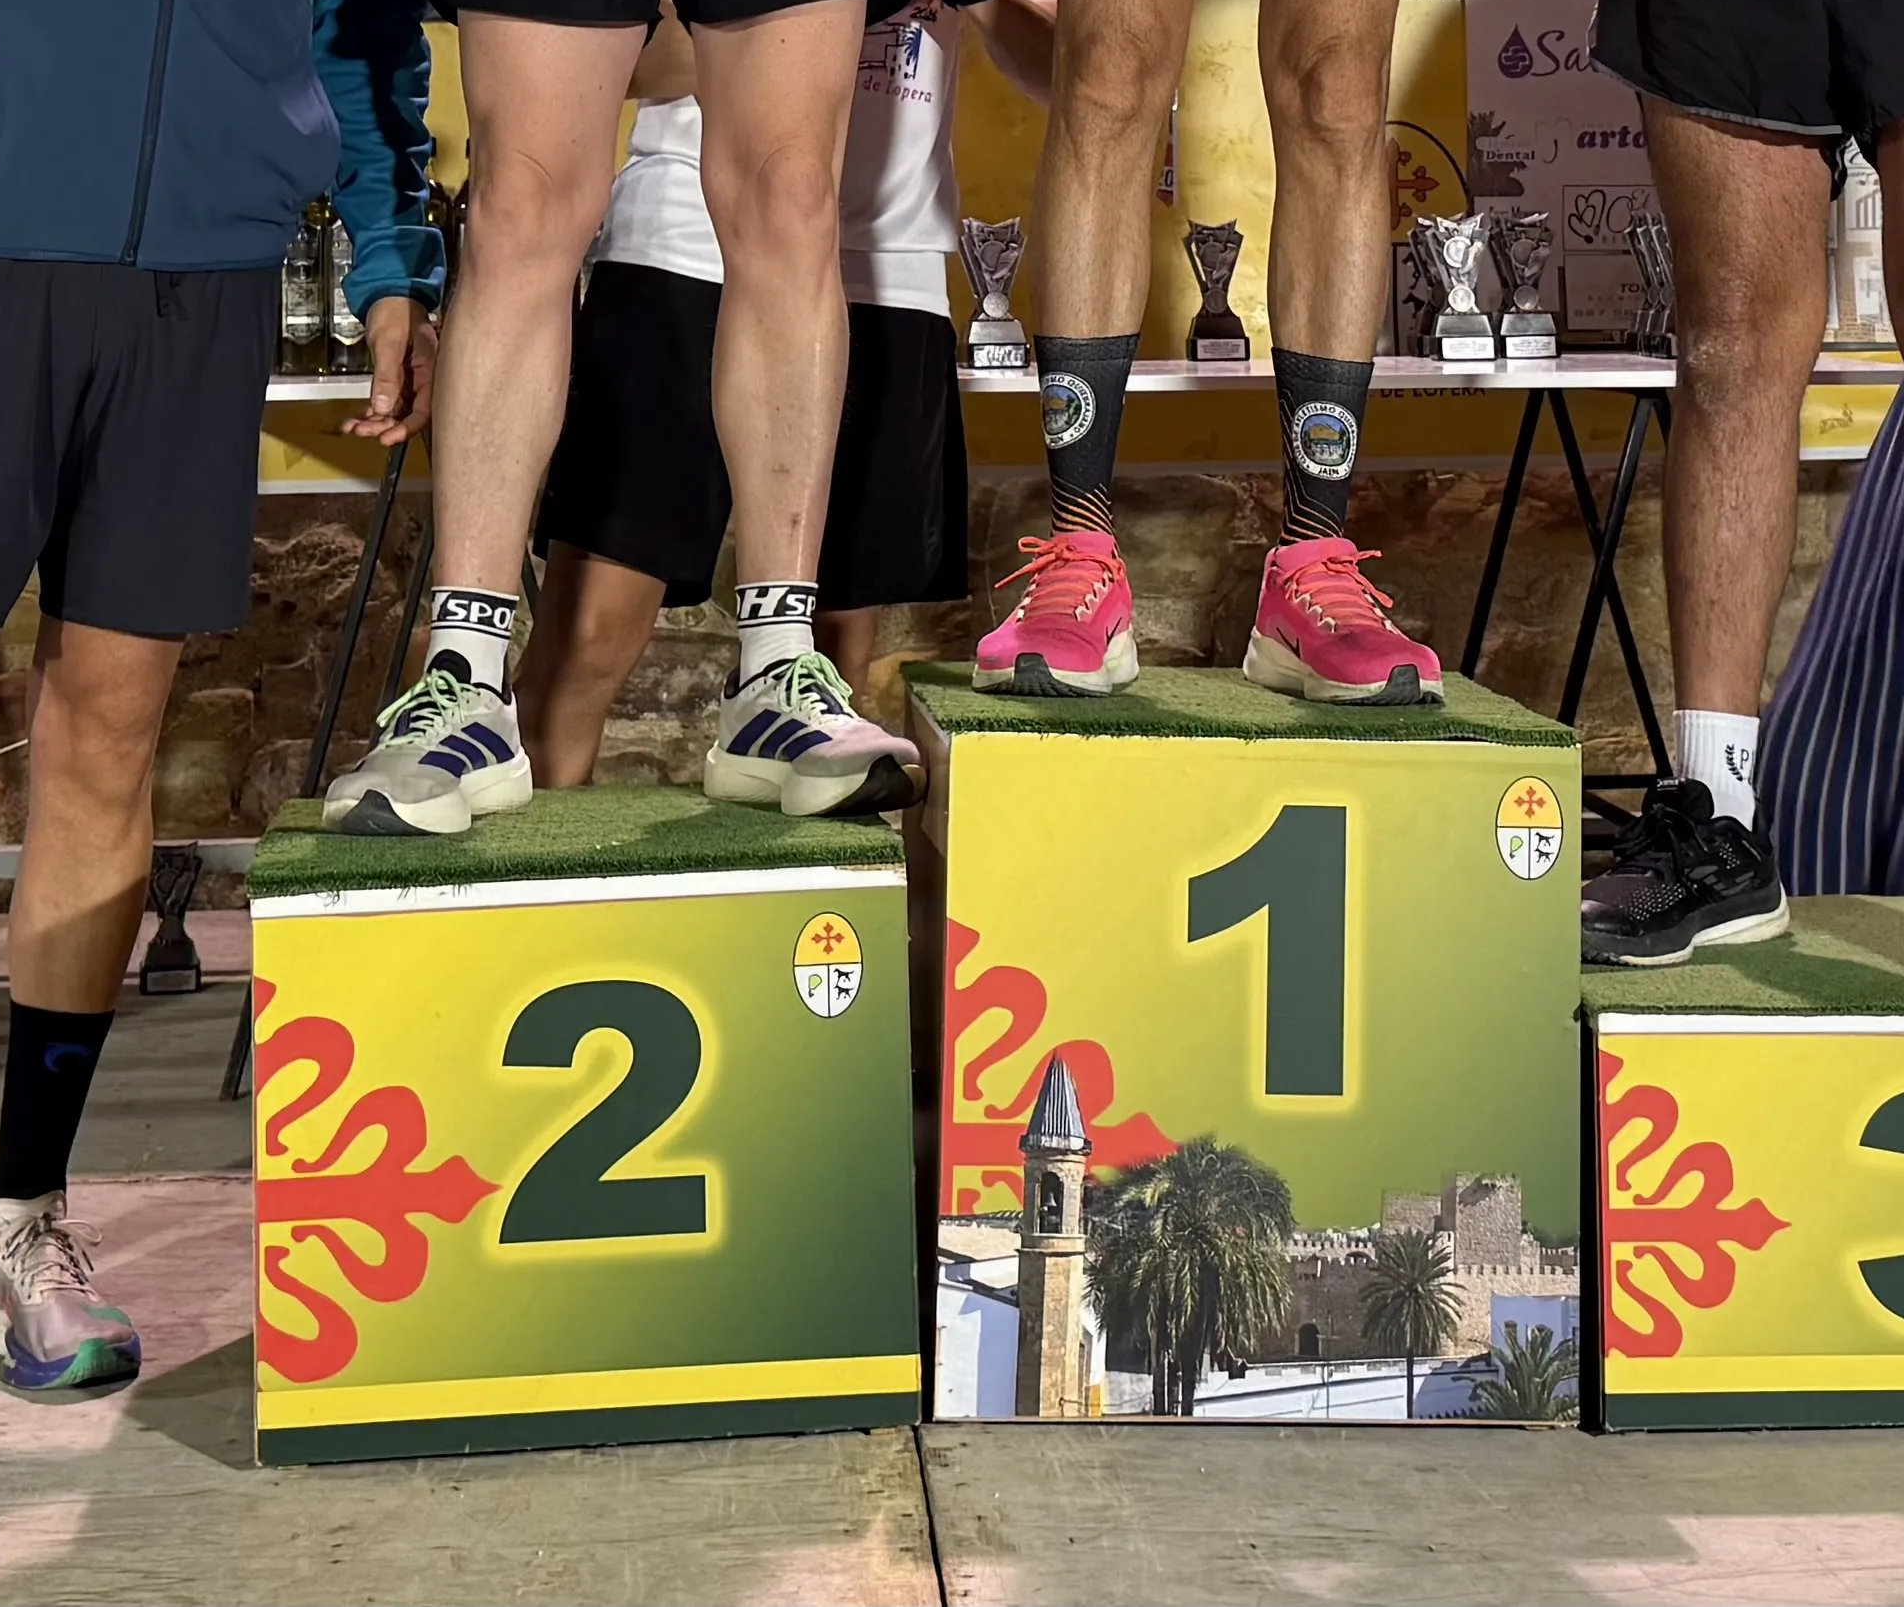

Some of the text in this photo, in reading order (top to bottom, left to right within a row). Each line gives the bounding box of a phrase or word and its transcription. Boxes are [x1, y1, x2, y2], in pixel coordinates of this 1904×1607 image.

[1530, 30, 1600, 76] Sa
[445, 598, 516, 630] SPO
[1188, 805, 1347, 1096] 1
[499, 980, 706, 1244] 2
